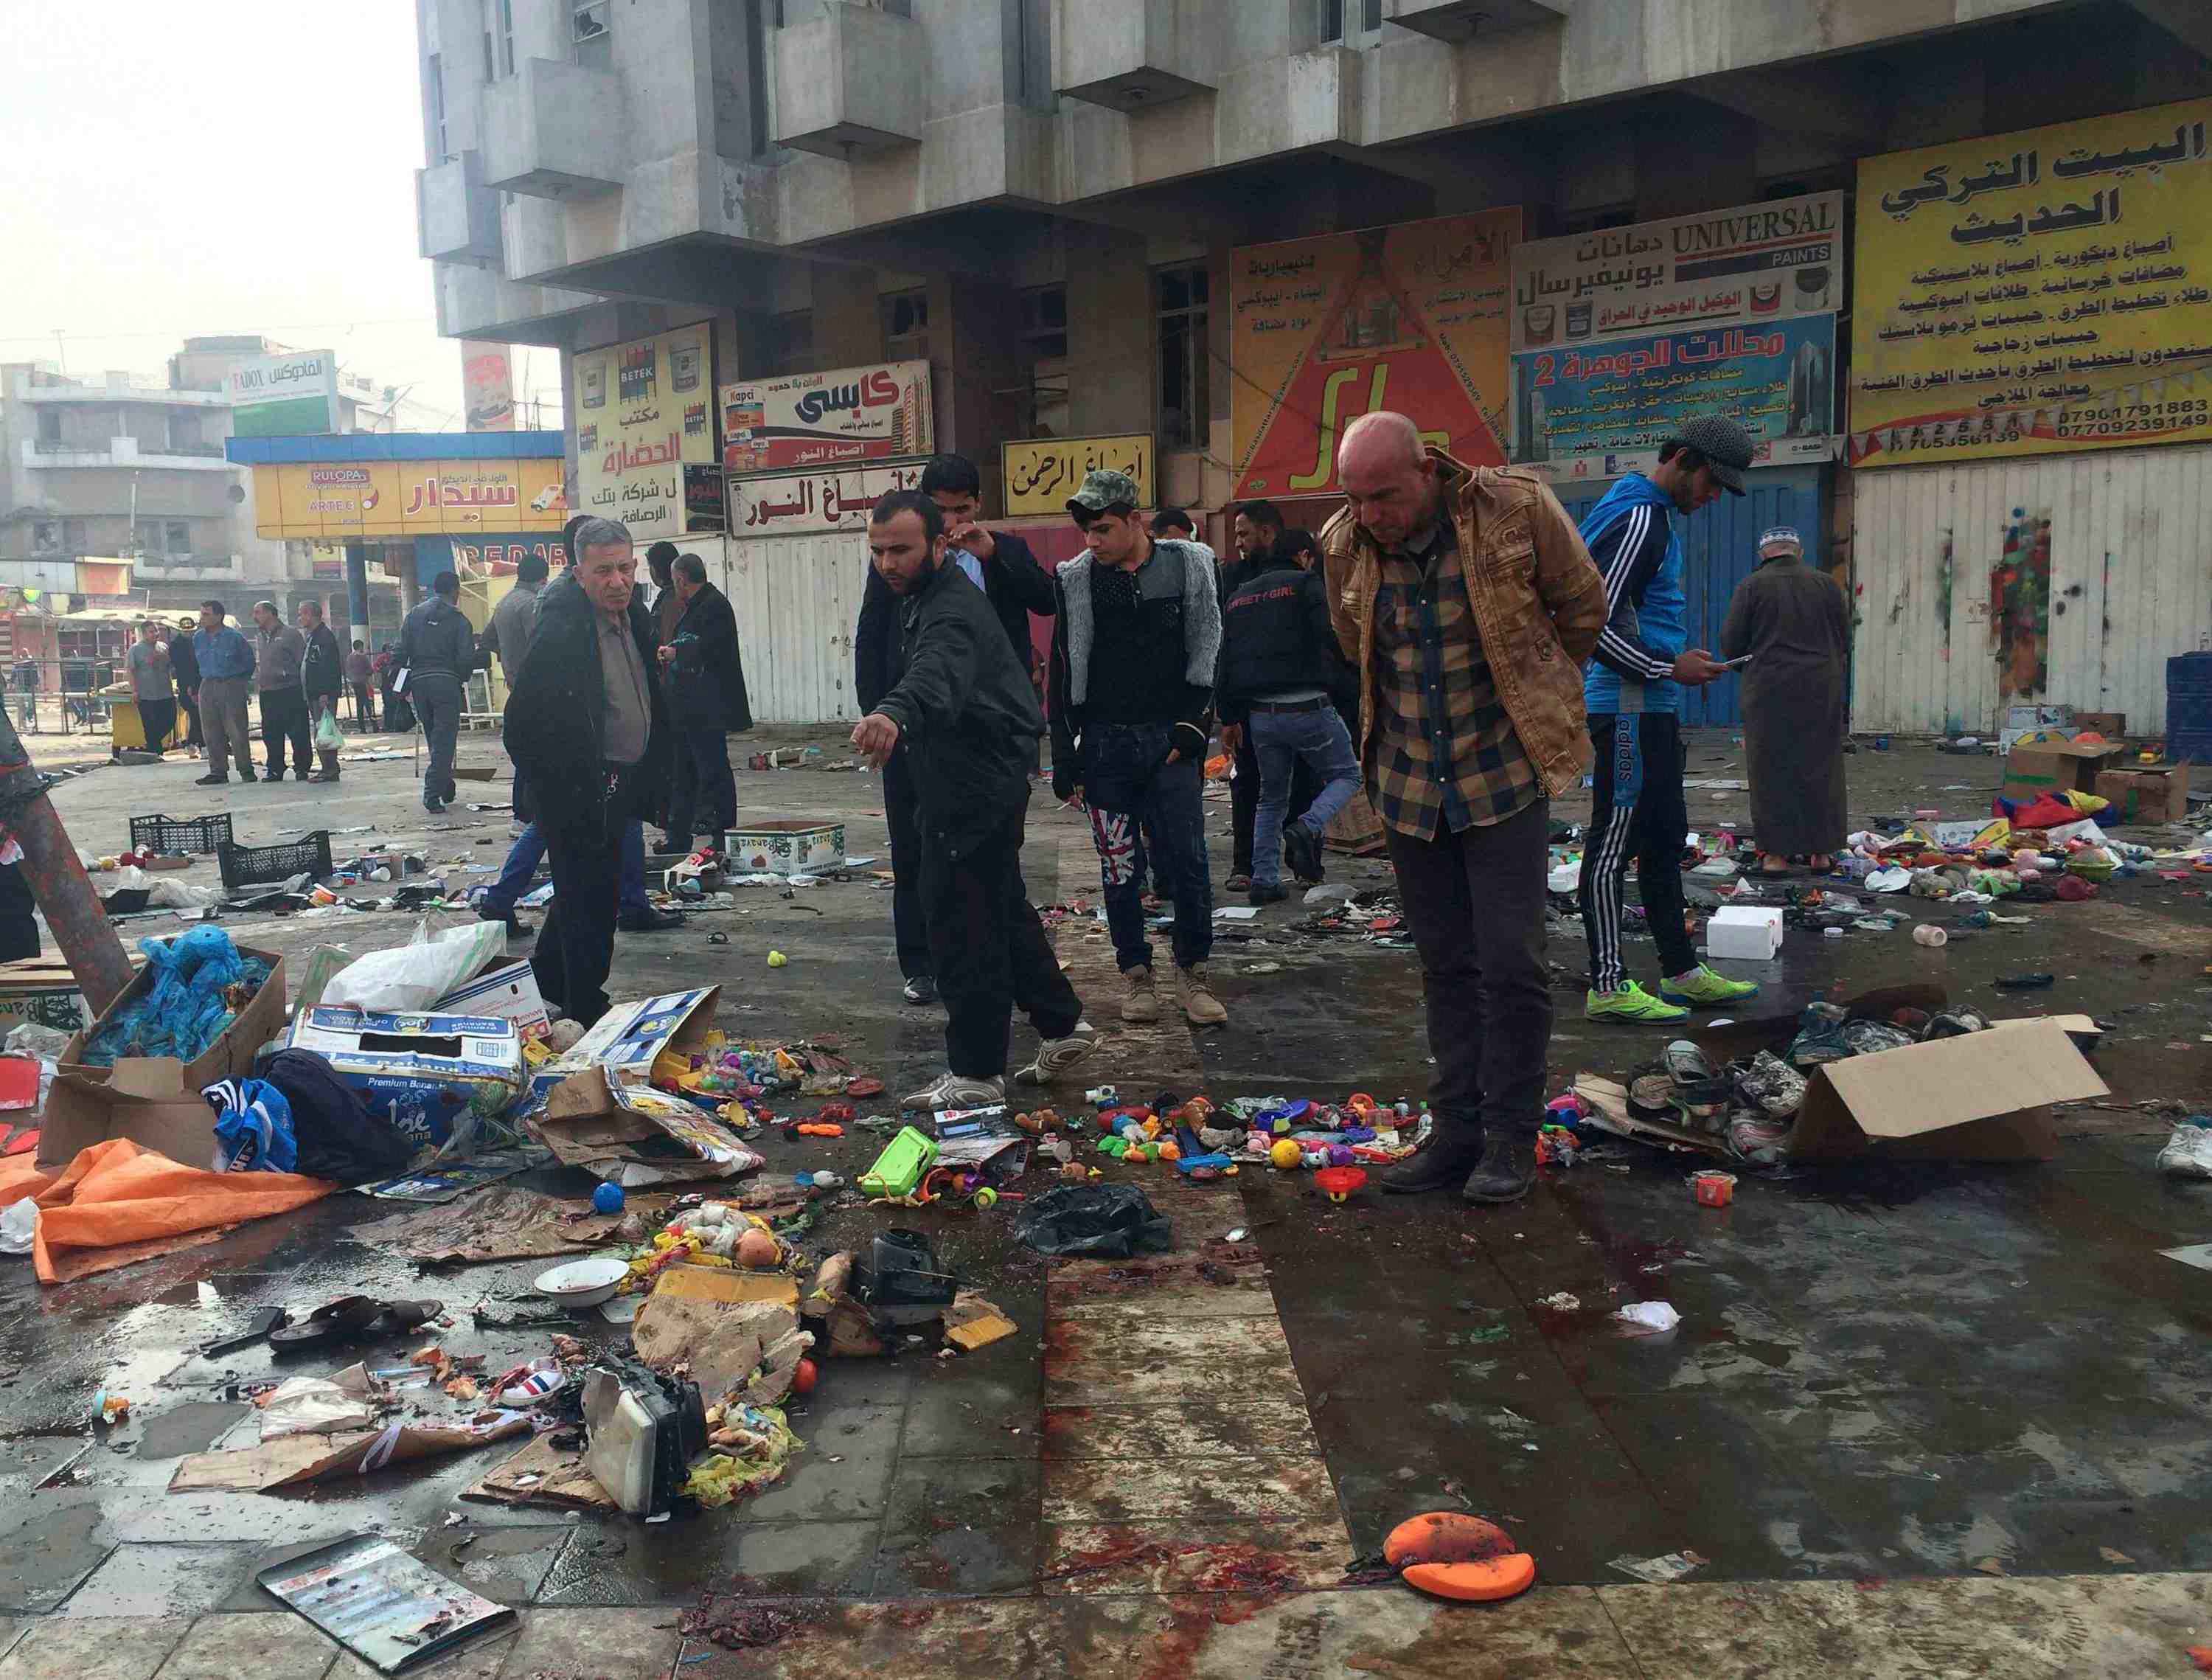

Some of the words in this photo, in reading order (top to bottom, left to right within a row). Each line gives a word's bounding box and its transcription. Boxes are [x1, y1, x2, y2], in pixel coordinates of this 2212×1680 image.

[2053, 122, 2207, 177] البيت
[1881, 150, 2040, 222] التركي
[1672, 202, 1836, 253] UNIVERSAL
[1950, 187, 2123, 246] الحديث
[1772, 246, 1829, 267] PAINTS
[621, 367, 653, 382] BETEK
[1533, 355, 1554, 387] 2
[730, 389, 754, 401] Kapci
[619, 407, 660, 429] مكتب
[622, 478, 659, 502] شركة
[745, 479, 813, 526] النور
[368, 1077, 407, 1088] Premium
